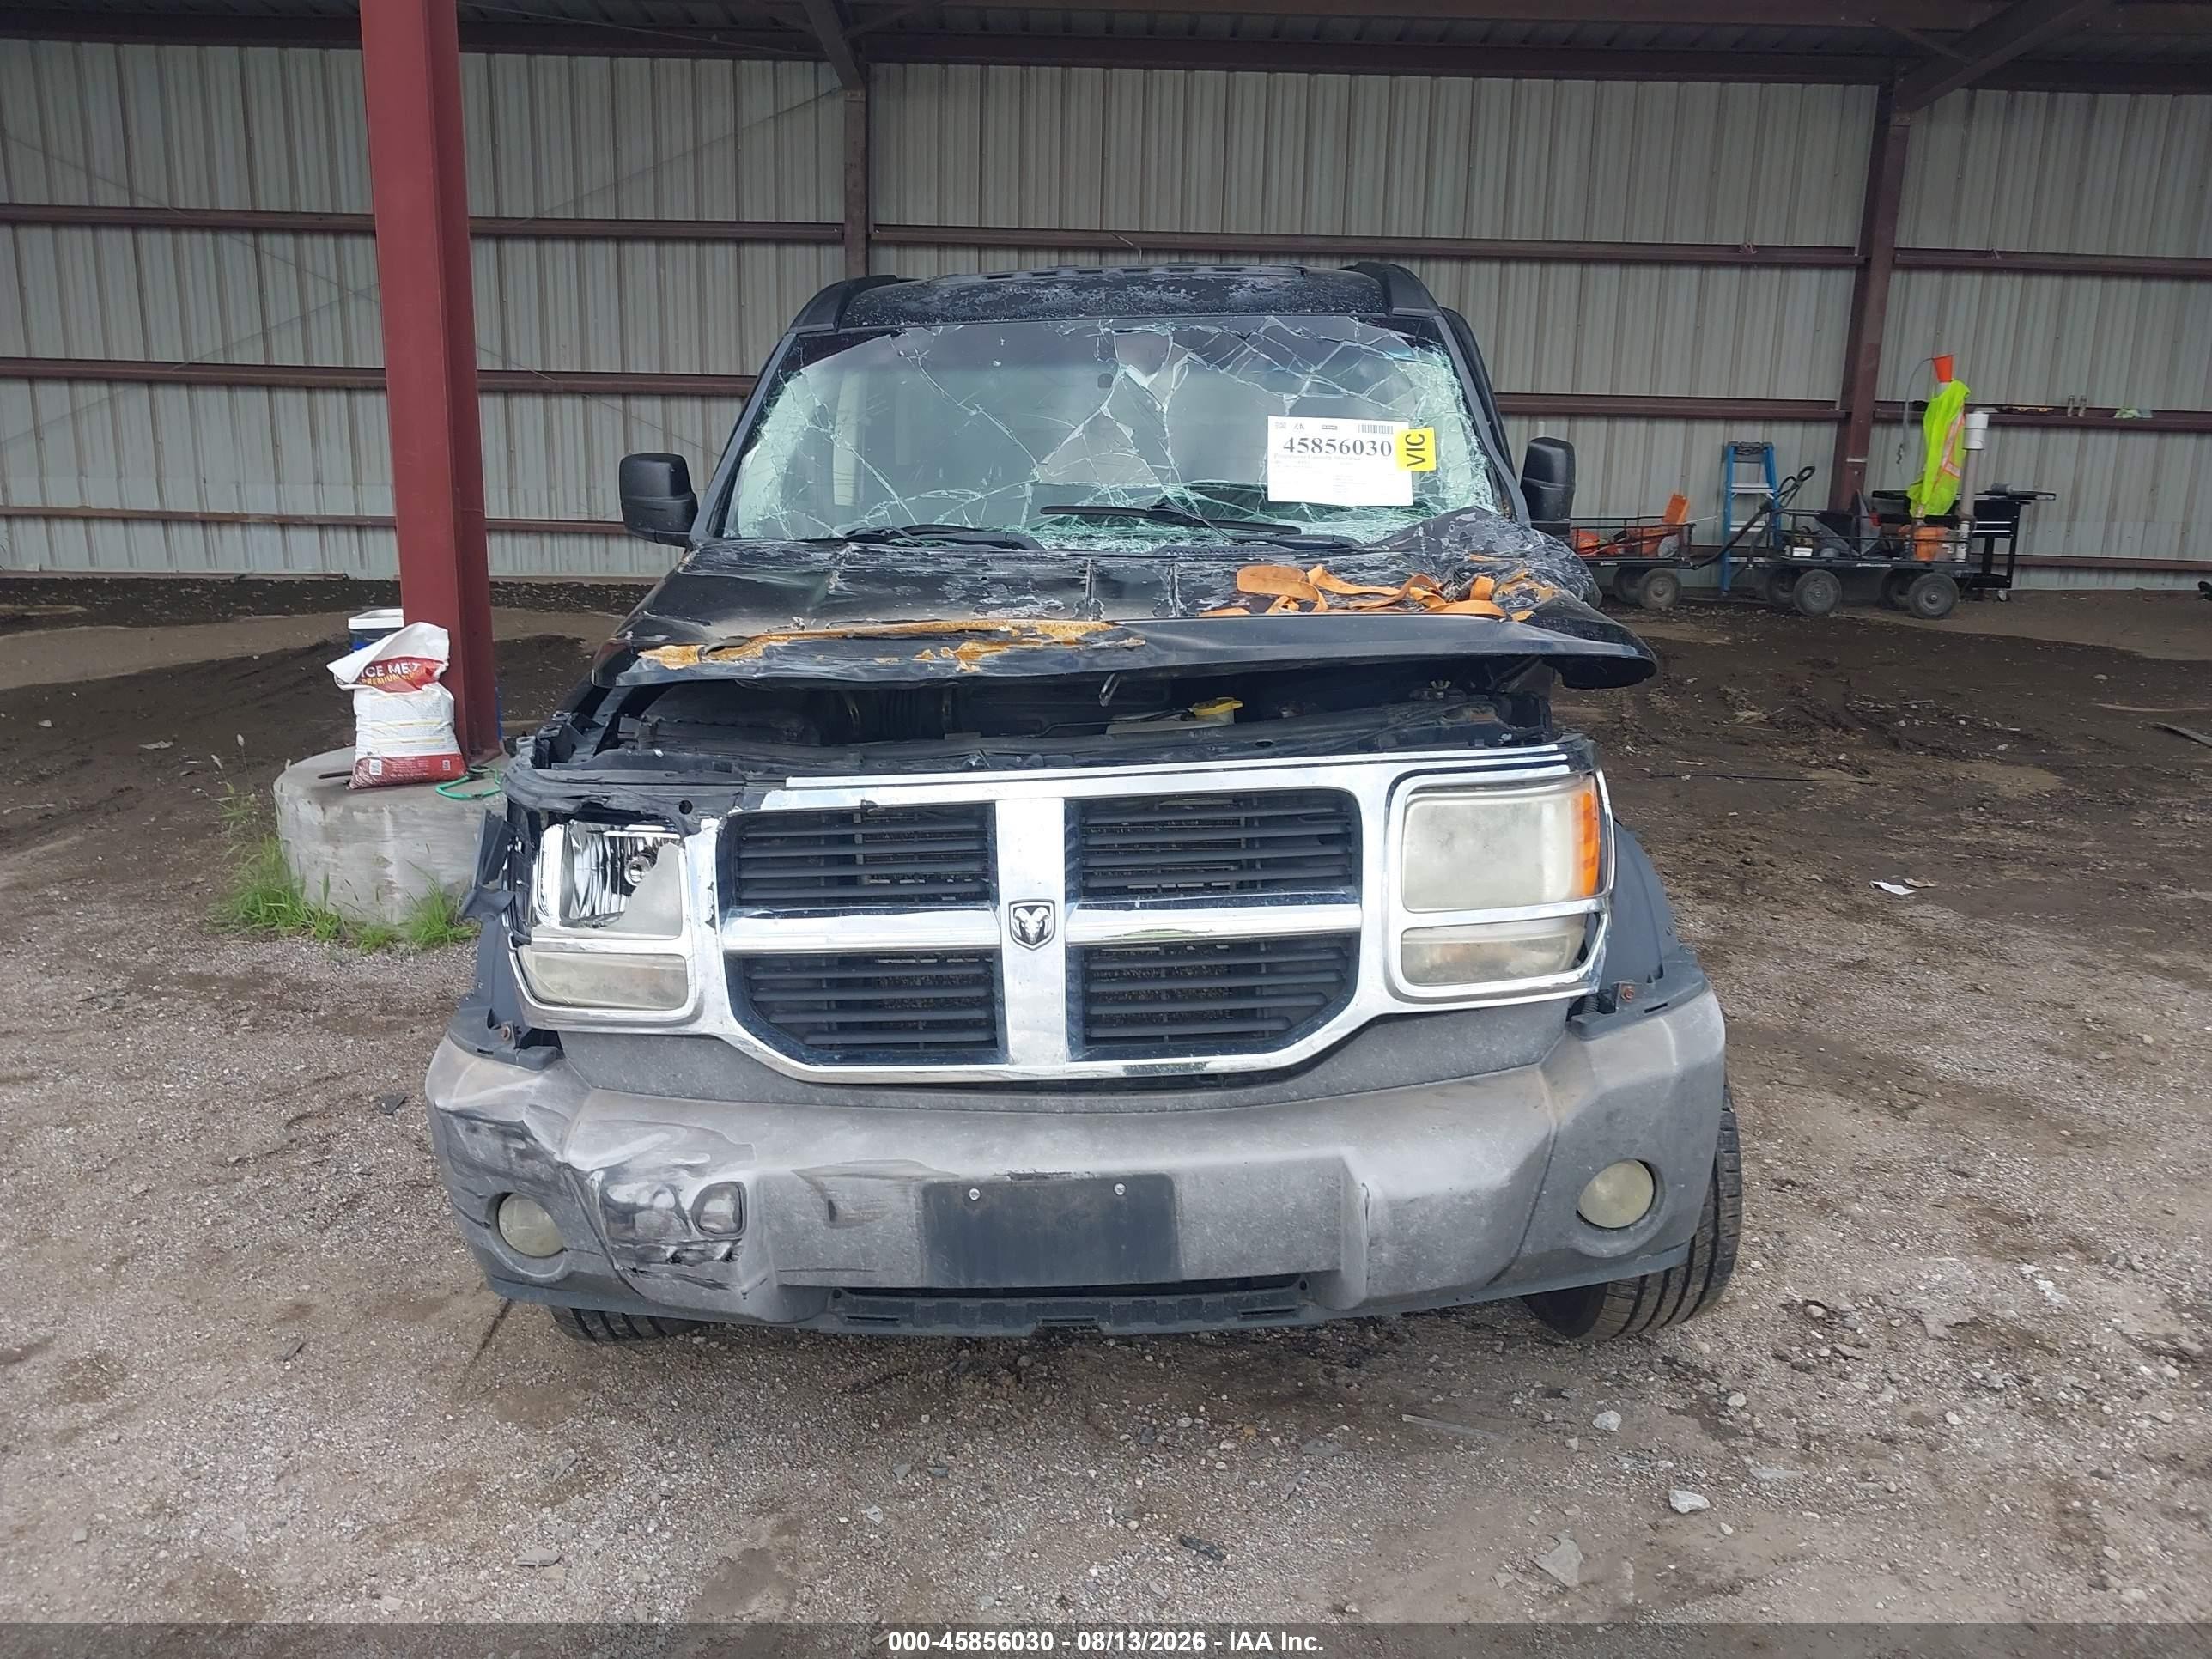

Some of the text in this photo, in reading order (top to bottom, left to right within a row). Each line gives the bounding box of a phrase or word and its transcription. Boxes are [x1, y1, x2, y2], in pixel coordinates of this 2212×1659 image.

[1283, 436, 1393, 457] 45856030
[1405, 432, 1426, 468] VIC
[361, 673, 401, 685] PREMIUM
